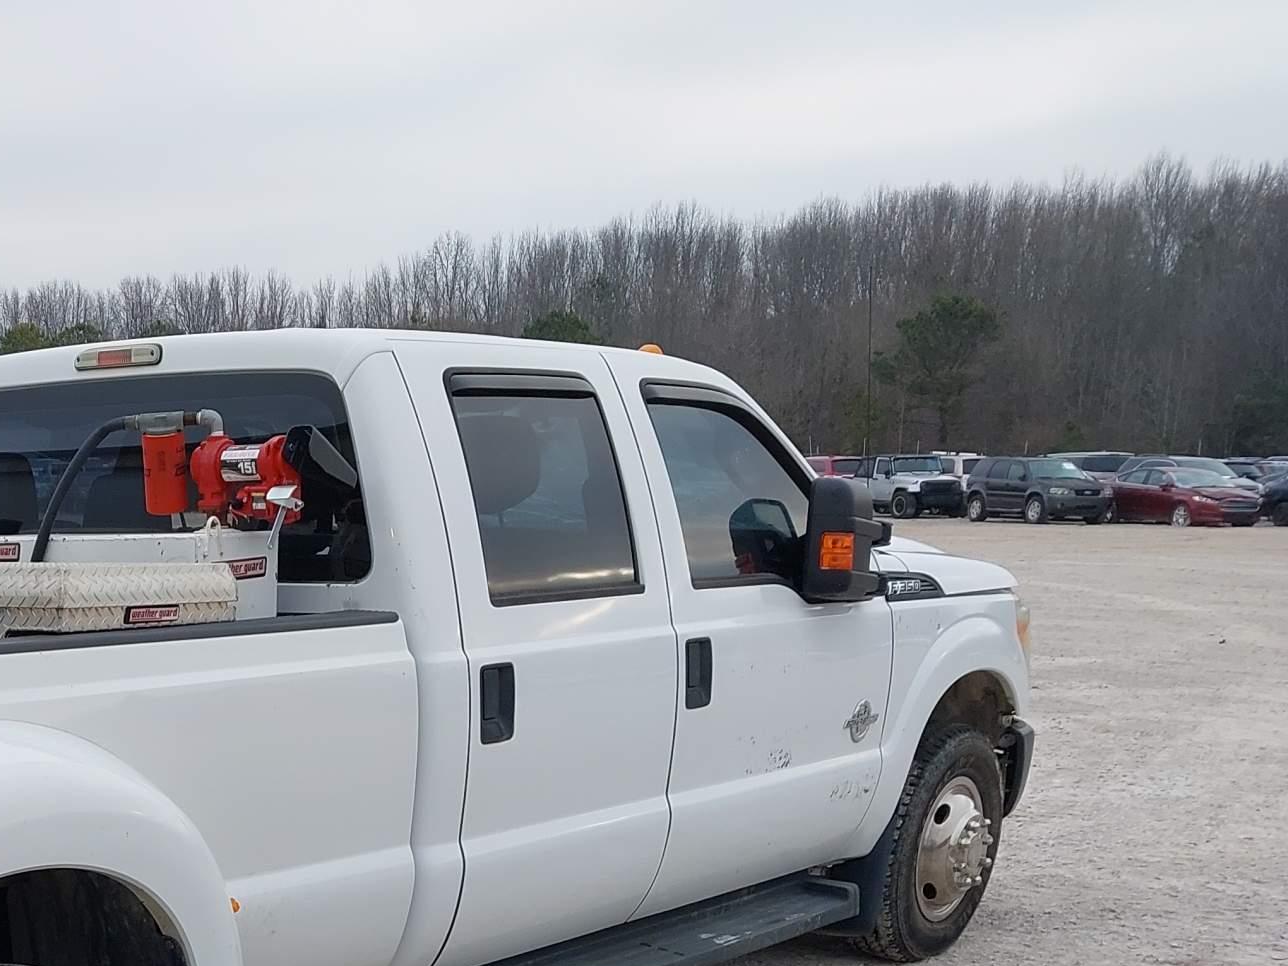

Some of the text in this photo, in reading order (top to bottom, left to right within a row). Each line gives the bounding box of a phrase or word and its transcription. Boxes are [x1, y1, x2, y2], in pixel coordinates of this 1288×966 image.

[244, 559, 264, 574] guard
[132, 607, 178, 619] weather guard
